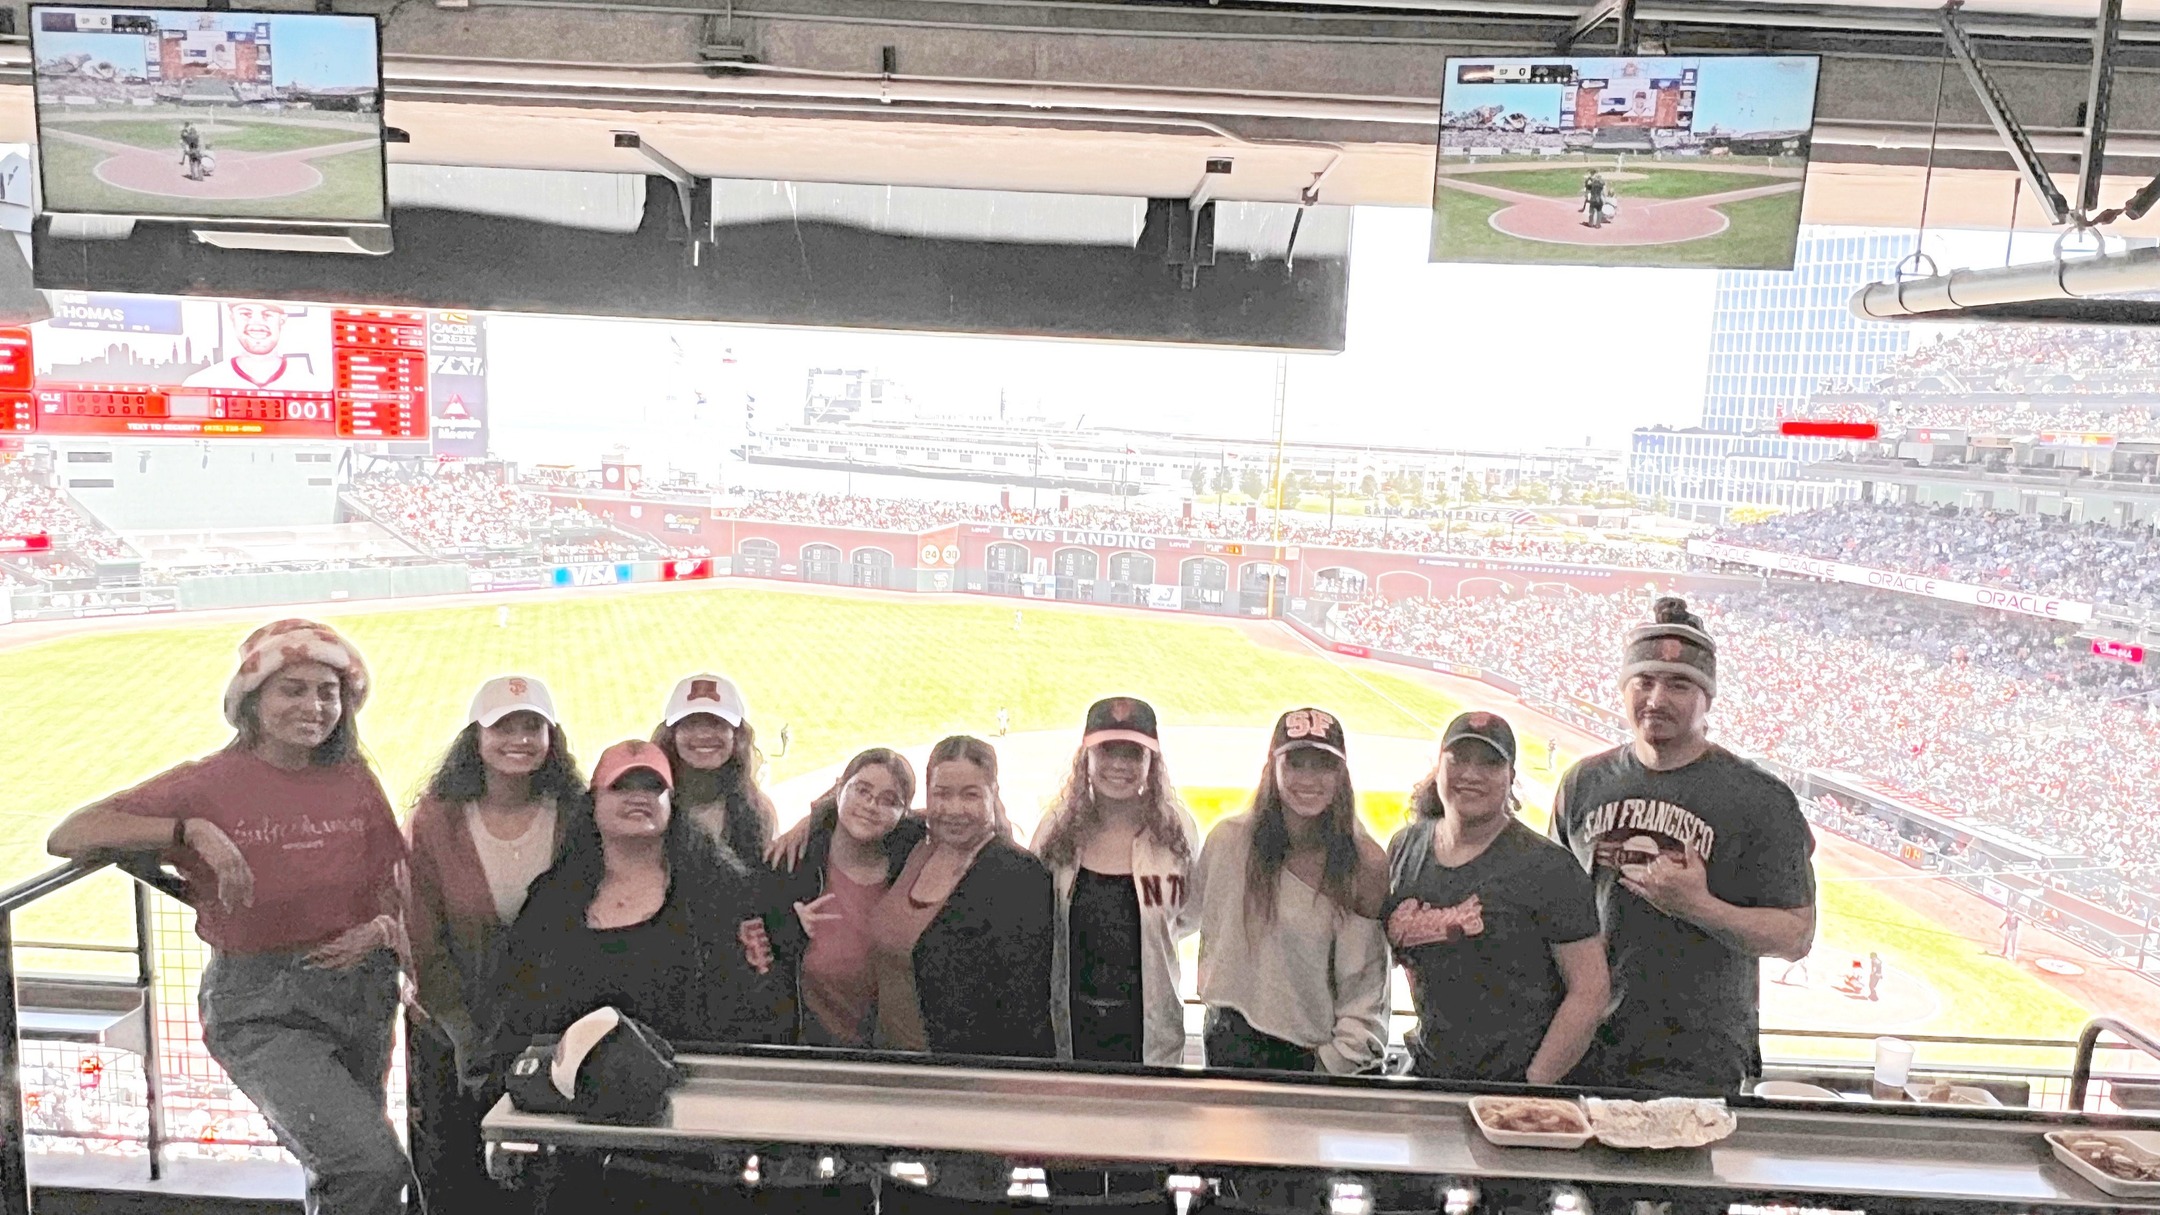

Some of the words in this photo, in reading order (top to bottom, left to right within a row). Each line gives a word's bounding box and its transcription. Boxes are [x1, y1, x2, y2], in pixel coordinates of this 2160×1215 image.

[60, 305, 124, 321] THOMAS
[431, 323, 477, 335] CACHE
[432, 333, 476, 346] CREEK
[41, 393, 60, 402] CLE
[1364, 506, 1404, 517] BANK
[1409, 509, 1425, 519] OF
[1431, 509, 1499, 522] AMERICA
[1062, 530, 1156, 549] LANDING
[925, 550, 937, 559] 24
[1702, 544, 1751, 561] ORACLE
[571, 564, 618, 585] VISA
[1778, 557, 1835, 577] ORACLE
[1868, 571, 1936, 595] ORACLE
[1976, 590, 2060, 616] ORACLE
[1285, 710, 1334, 739] SF
[1584, 801, 1619, 843] SAN
[1618, 798, 1714, 861] FRANCISCO
